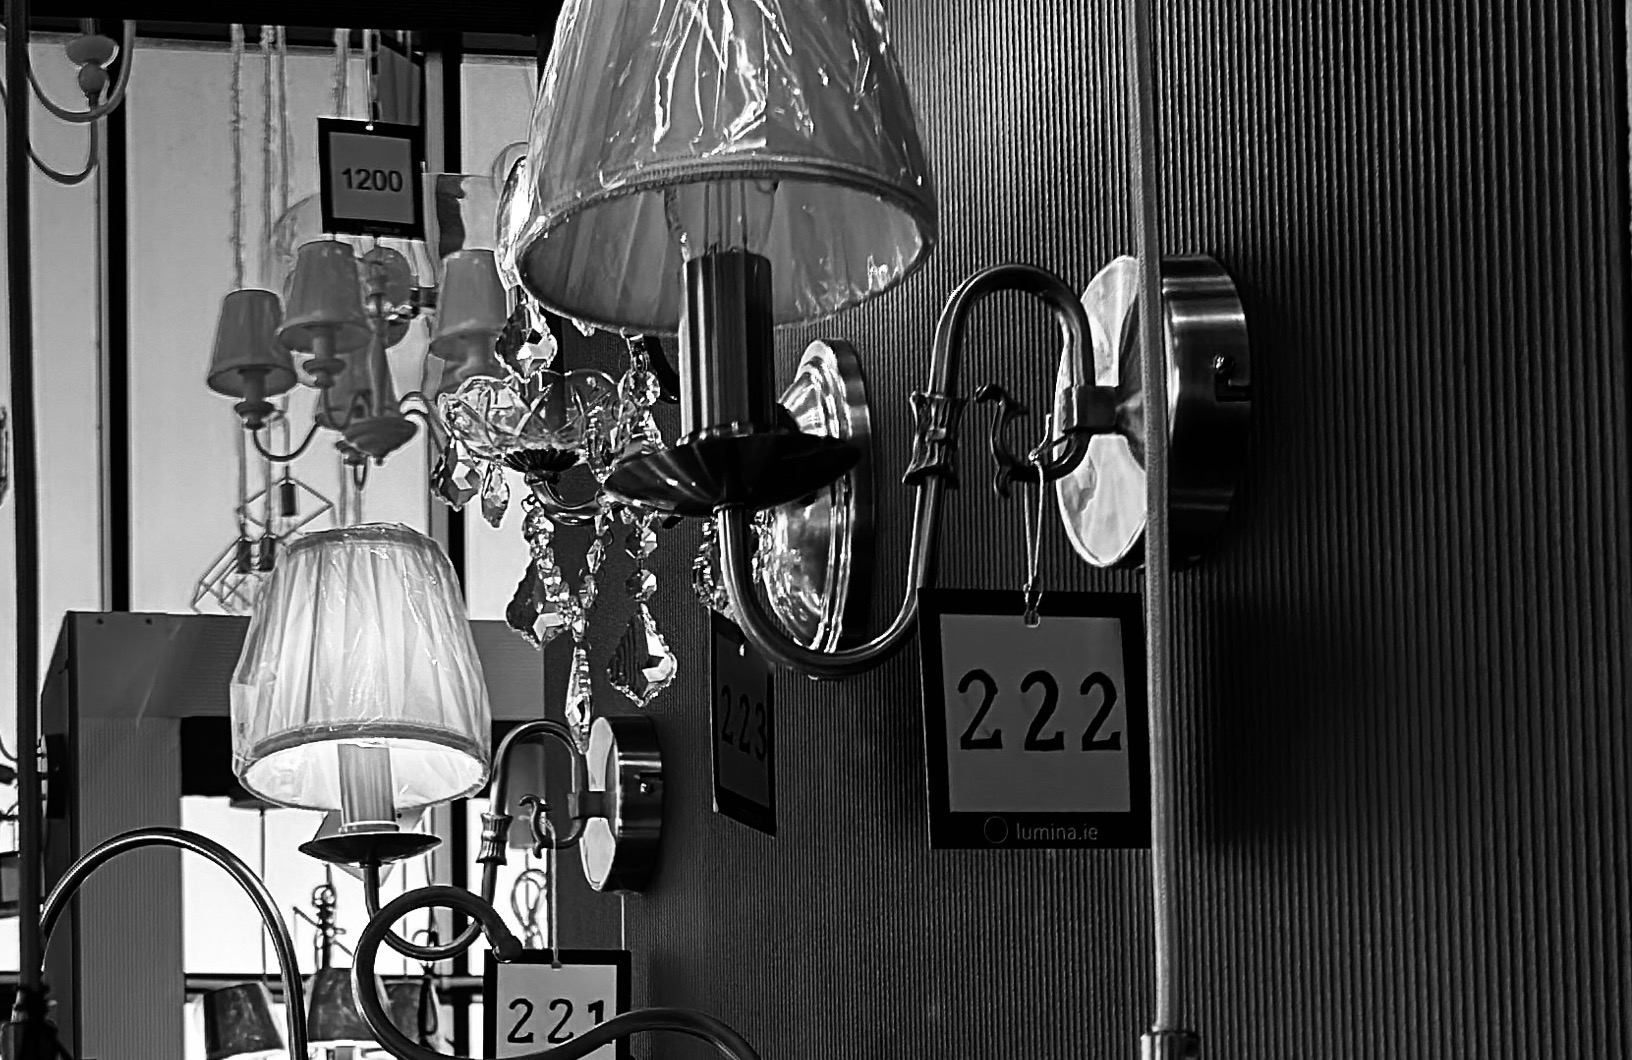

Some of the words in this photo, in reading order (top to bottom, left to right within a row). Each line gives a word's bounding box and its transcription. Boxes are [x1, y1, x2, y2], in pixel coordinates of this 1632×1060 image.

[342, 168, 403, 193] 1200
[721, 684, 767, 763] 223
[957, 668, 1122, 751] 222
[1016, 822, 1099, 841] lumina.ie
[507, 998, 613, 1044] 221
